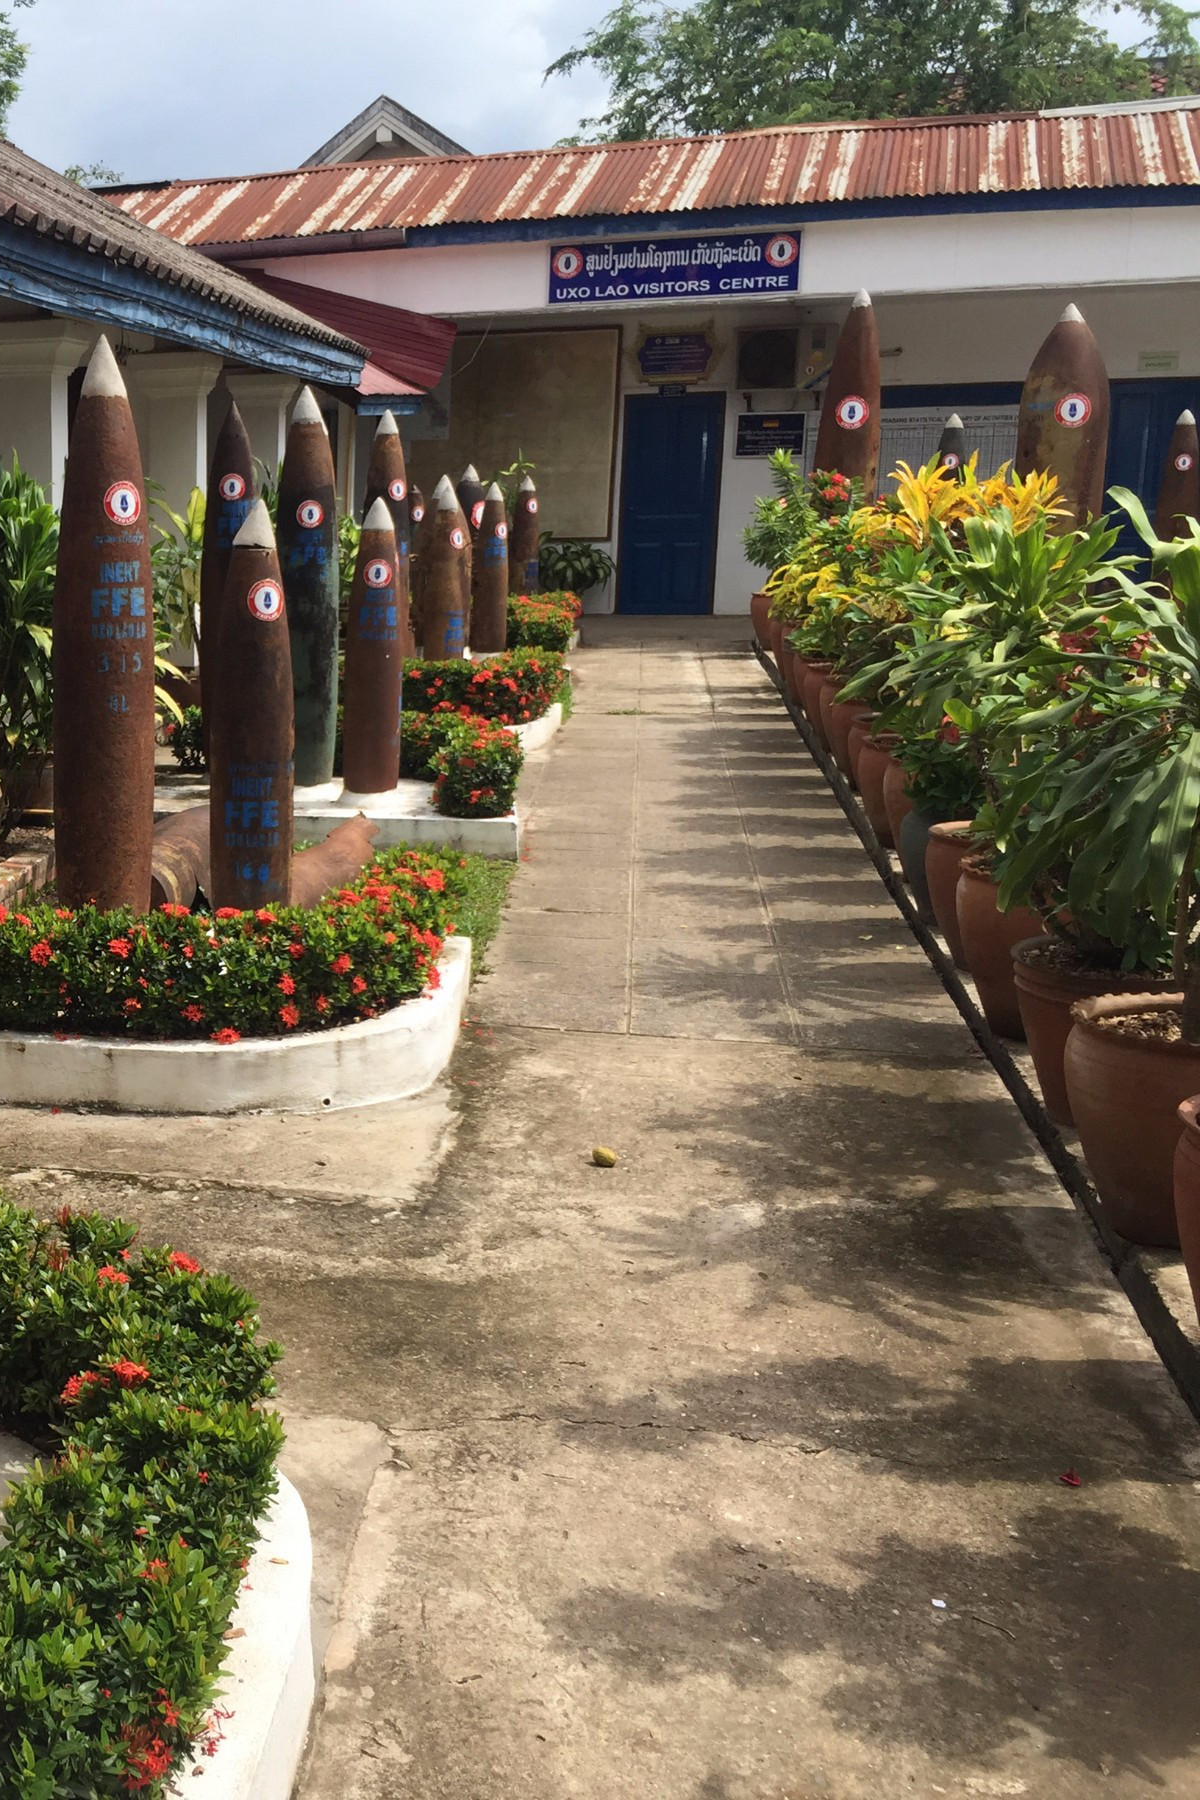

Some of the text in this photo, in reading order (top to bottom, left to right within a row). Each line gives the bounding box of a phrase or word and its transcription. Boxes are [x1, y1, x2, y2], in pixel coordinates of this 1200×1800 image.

[556, 275, 789, 300] UXO LAO VISITORS CENTRE
[99, 561, 140, 583] INERT
[91, 587, 146, 618] FFE
[224, 800, 279, 828] FFE
